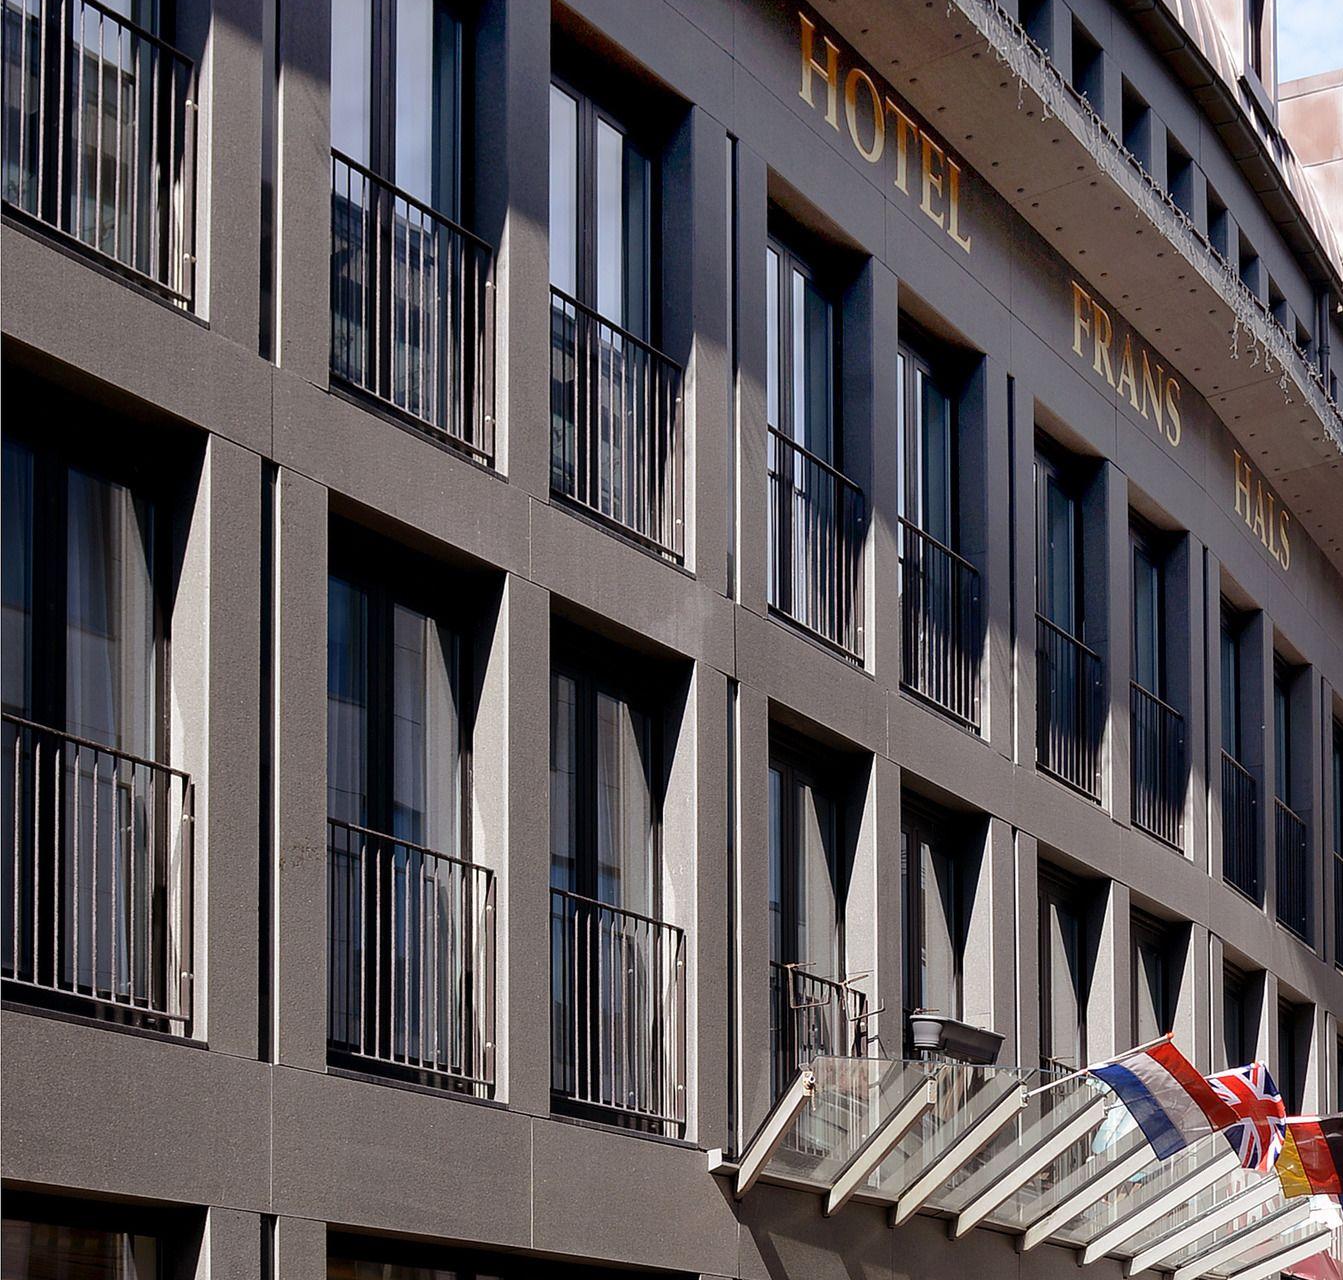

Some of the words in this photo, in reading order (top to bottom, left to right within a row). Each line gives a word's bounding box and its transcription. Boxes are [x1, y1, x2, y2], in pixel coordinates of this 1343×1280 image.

[797, 12, 973, 254] HOTEL
[1069, 279, 1184, 449] FRANS
[1233, 448, 1292, 572] HALS
